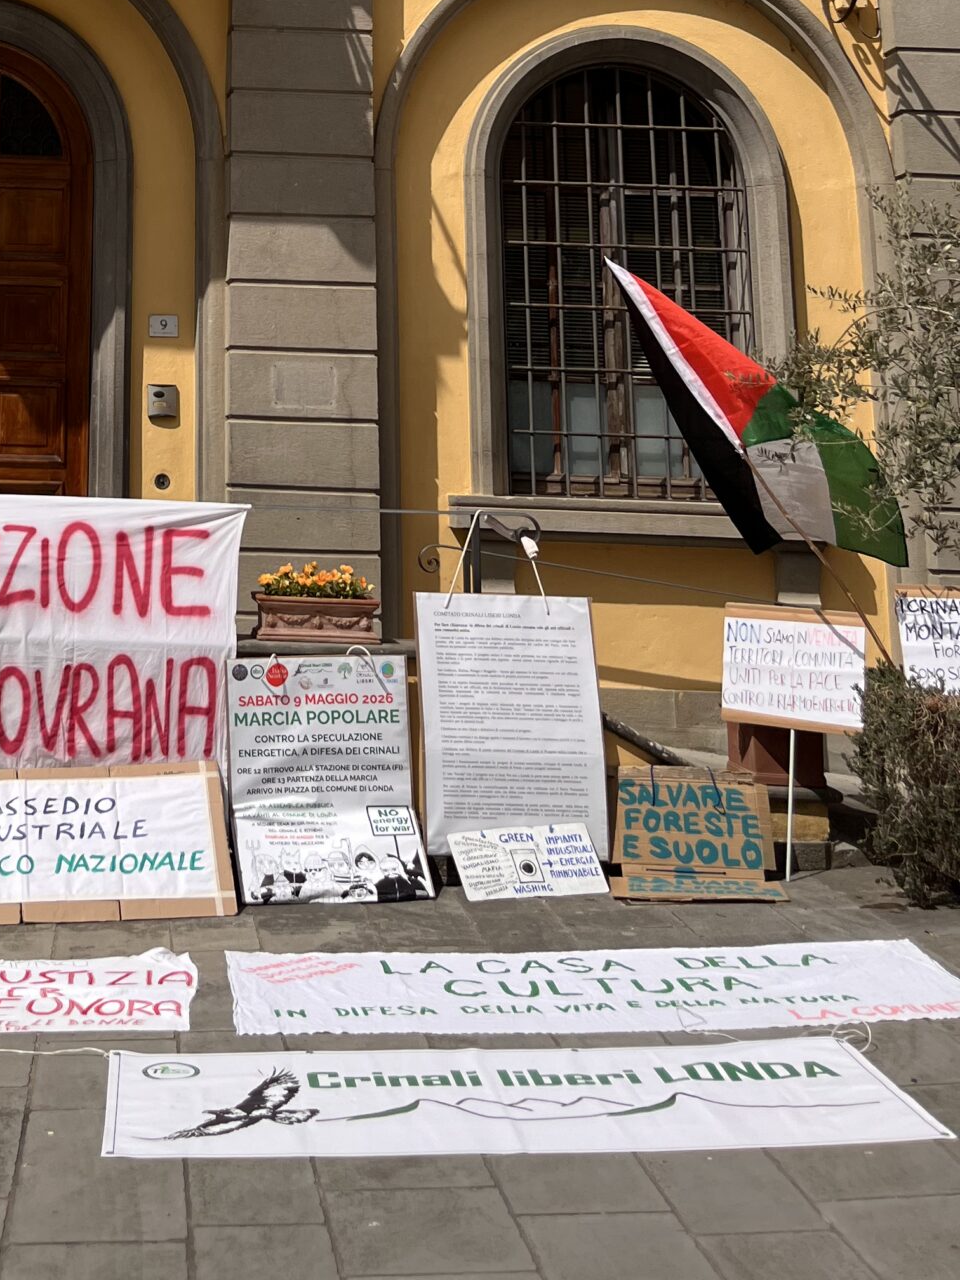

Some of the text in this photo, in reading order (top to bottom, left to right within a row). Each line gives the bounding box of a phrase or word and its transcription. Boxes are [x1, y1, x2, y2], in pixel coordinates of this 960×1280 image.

[159, 319, 168, 331] 9
[726, 620, 761, 644] NON
[809, 671, 844, 690] PACE
[238, 692, 394, 707] SABATO 9 MAGGIO 2026
[233, 709, 400, 727] MARCIA POPOLARE
[254, 732, 383, 744] CONTRO LA SPECULAZIONE
[301, 747, 308, 756] A
[310, 747, 344, 756] DIFESA
[345, 747, 361, 756] DEI
[362, 746, 400, 755] CRINALI
[237, 767, 252, 775] ORE
[263, 766, 294, 775] RITROVO
[295, 765, 314, 773] ALLA
[315, 764, 350, 772] STAZIONE
[286, 775, 324, 784] PARTENZA
[246, 787, 273, 795] ARRIVO
[284, 786, 310, 794] PIAZZA
[326, 785, 358, 793] COMUNE
[618, 778, 751, 811] SALVARE
[378, 809, 399, 818] NO
[373, 817, 409, 826] energy
[624, 808, 764, 839] FORESTE
[375, 825, 411, 833] for war
[499, 832, 534, 843] GREEN
[545, 834, 582, 845] IMPIANTI
[547, 844, 594, 855] INDUSTRIALI
[623, 834, 763, 870] E SUOLO
[54, 850, 207, 876] NAZIONALE
[559, 856, 595, 866] ENERGIA
[550, 867, 600, 878] RINNOVABILE
[513, 884, 554, 894] WASHING
[379, 959, 454, 975] LA
[476, 957, 636, 974] CASA
[673, 953, 838, 971] DELLA
[443, 976, 762, 997] CULTURA
[274, 994, 860, 1018] IN DIFESA DELLA VITA E DELLA NATURA
[787, 1008, 847, 1021] LA
[67, 1018, 147, 1027] DONNE
[307, 1061, 841, 1089] Crinali liberi LONDA
